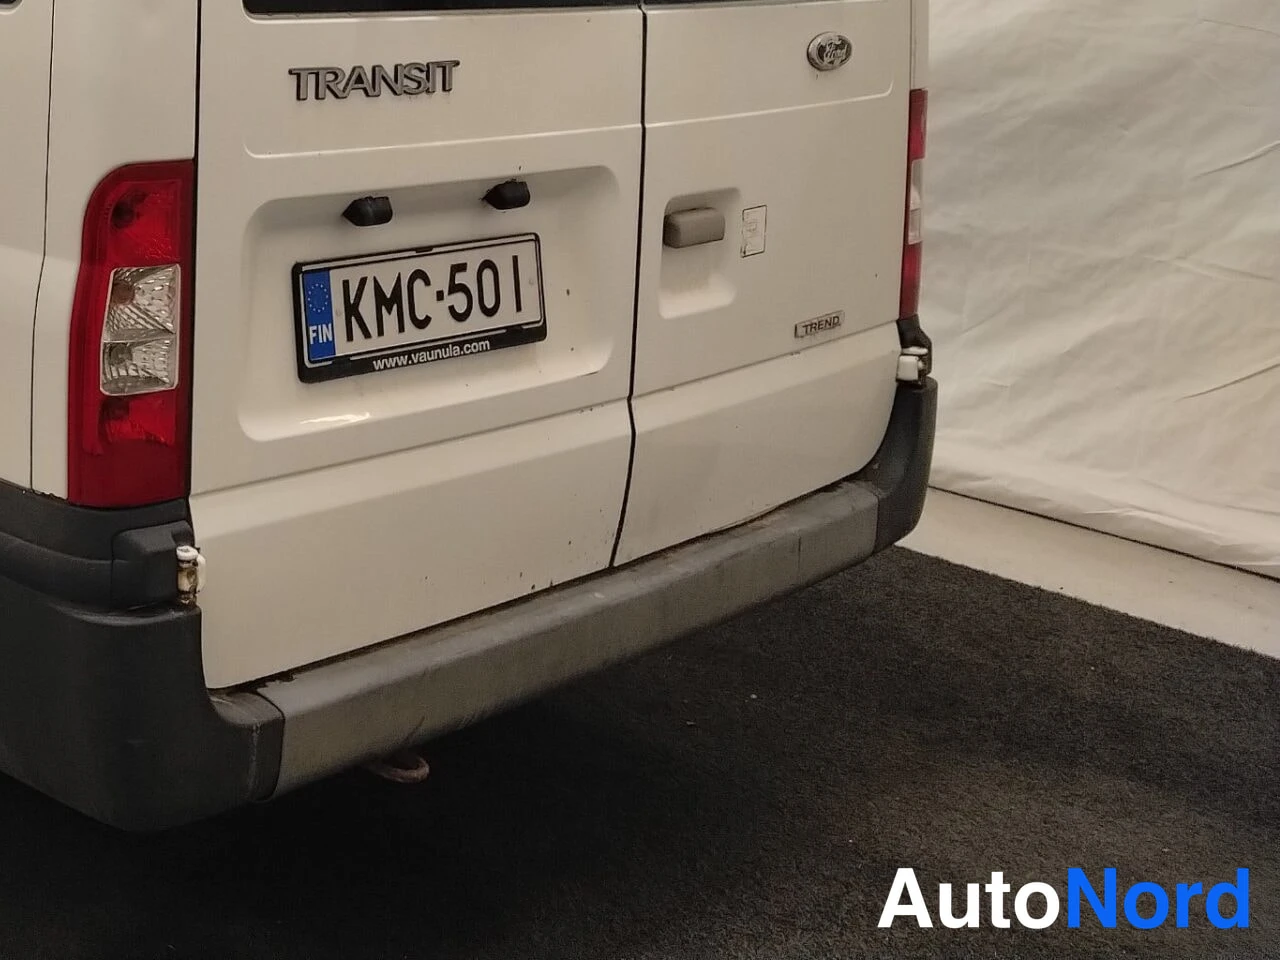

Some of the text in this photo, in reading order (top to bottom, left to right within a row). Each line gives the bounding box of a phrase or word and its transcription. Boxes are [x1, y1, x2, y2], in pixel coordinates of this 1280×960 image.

[288, 59, 461, 101] TRANSIT
[308, 323, 333, 345] FIN
[801, 315, 841, 336] TREND
[372, 339, 491, 372] www.vaunula.com
